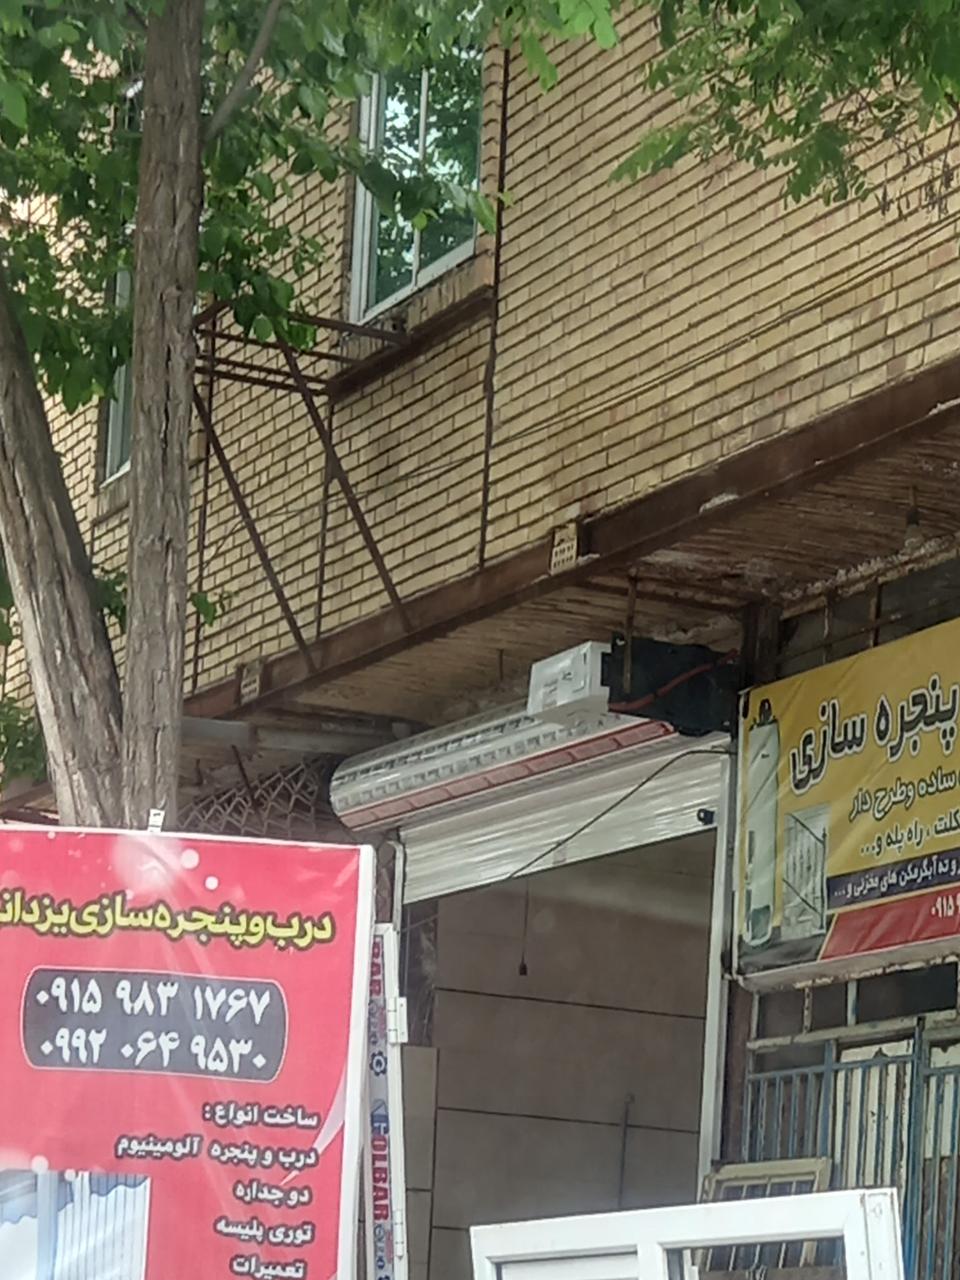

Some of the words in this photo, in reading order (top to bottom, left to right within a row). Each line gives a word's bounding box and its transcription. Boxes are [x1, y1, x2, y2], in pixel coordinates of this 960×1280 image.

[874, 674, 960, 762] پنجره
[790, 699, 868, 795] سازی
[917, 766, 957, 797] ساده
[849, 787, 872, 823] دار
[885, 825, 905, 853] پله
[906, 819, 925, 848] راه
[0, 888, 70, 937] یزدان
[36, 977, 102, 1014] ۰۹۱۵
[116, 979, 179, 1017] ۹۸۳
[194, 985, 271, 1025] ۱۷۶۷
[41, 1027, 107, 1064] ۰۹۹۲
[120, 1030, 181, 1068] ۰۶۴
[190, 1034, 268, 1074] ۹۵۳۰
[263, 1106, 319, 1127] ساخت
[116, 1135, 202, 1160] آلومینیوم
[209, 1141, 258, 1166] پنجره
[261, 1148, 273, 1166] و
[278, 1150, 318, 1169] درب
[234, 1180, 284, 1205] جداره
[287, 1187, 311, 1208] دو
[215, 1217, 264, 1243] پلیسه
[268, 1222, 314, 1246] توری
[231, 1255, 306, 1280] تعمیرات
